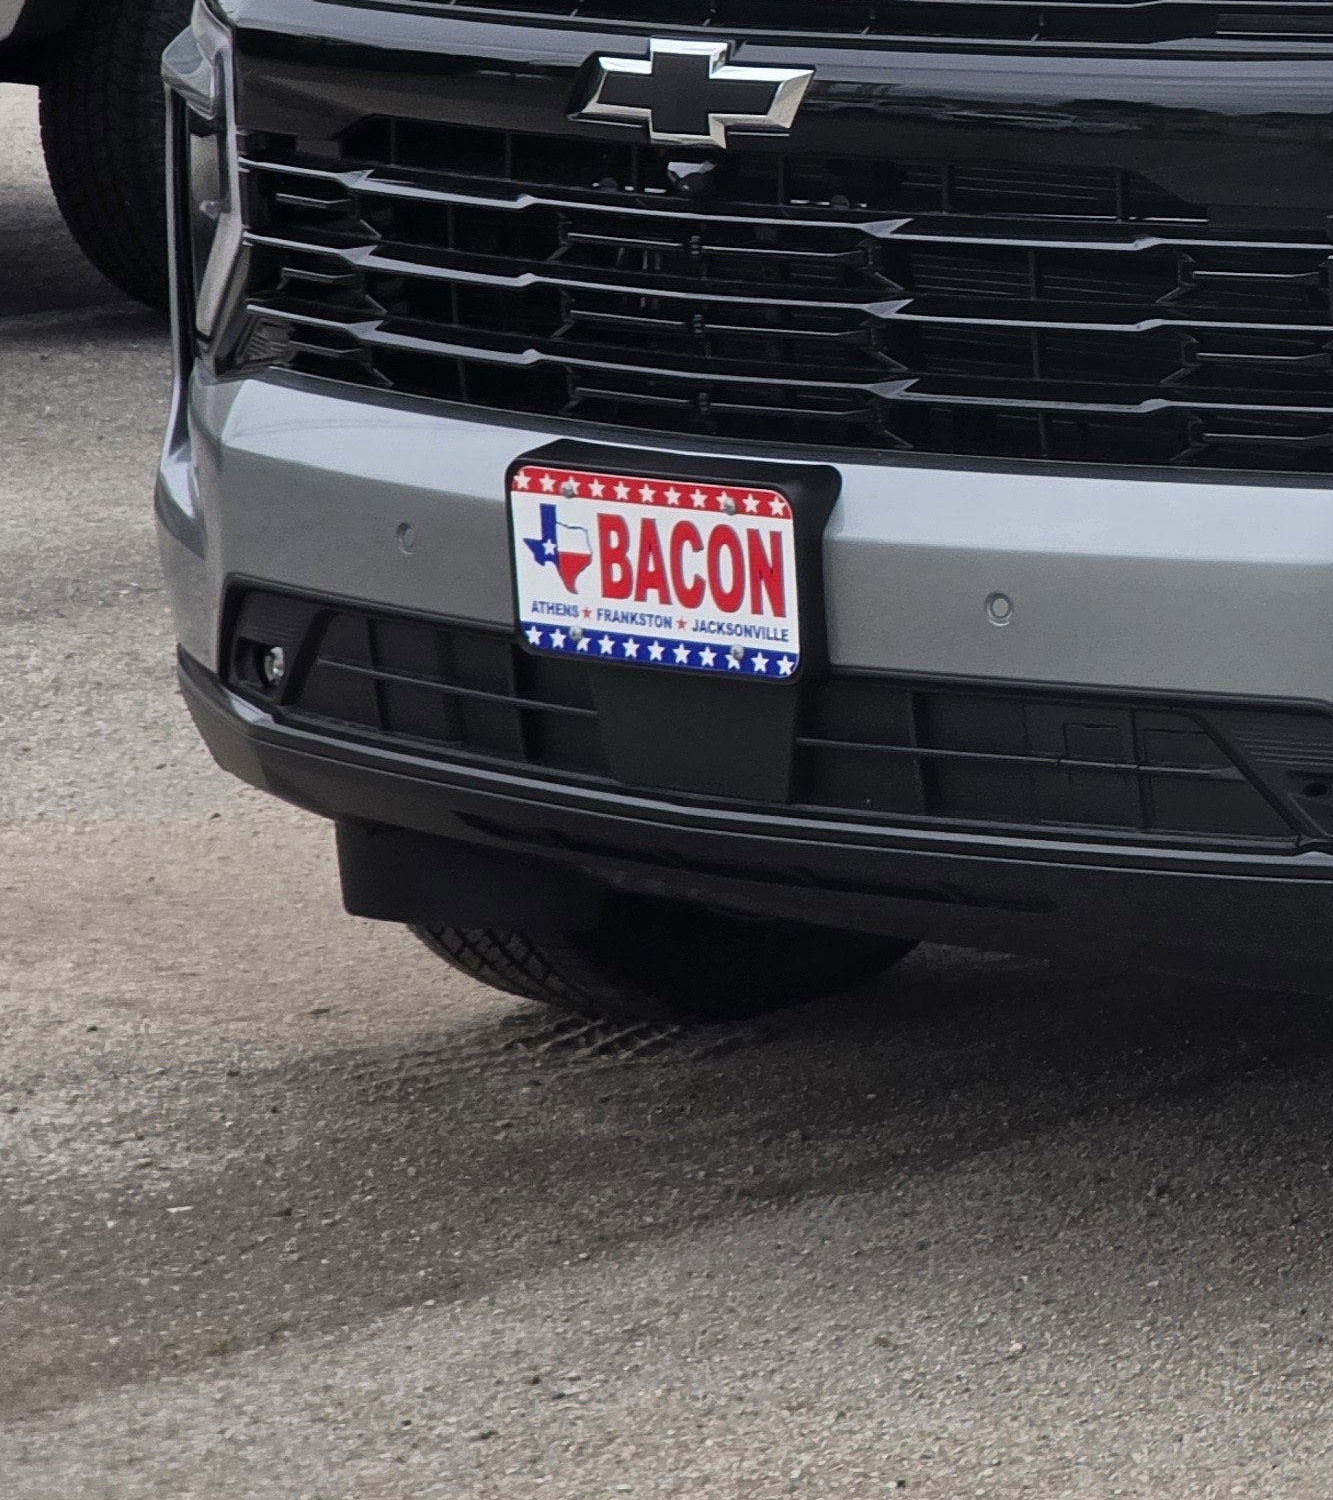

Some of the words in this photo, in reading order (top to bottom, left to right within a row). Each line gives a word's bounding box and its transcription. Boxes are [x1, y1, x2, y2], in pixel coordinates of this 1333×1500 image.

[597, 513, 786, 618] BACON
[531, 601, 580, 618] ATHENS
[596, 608, 673, 629] FRANKSTON
[692, 619, 790, 643] JACKSONVILLE
